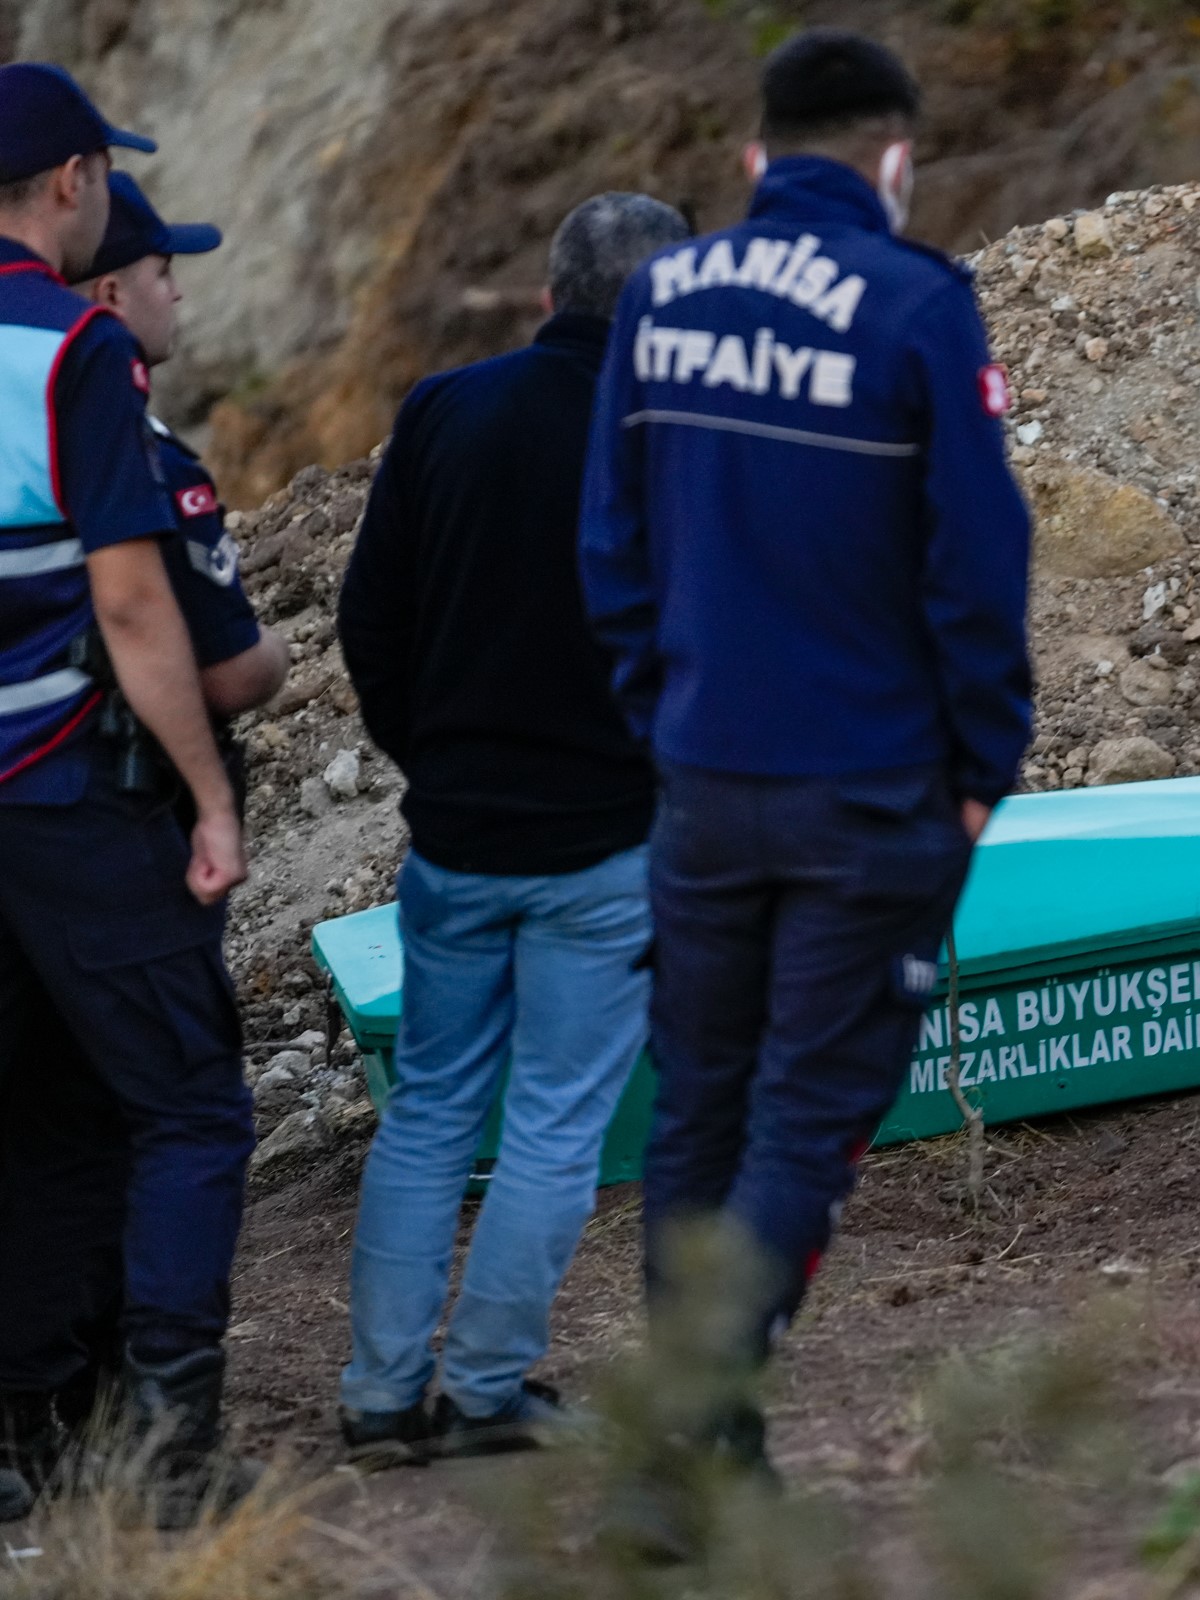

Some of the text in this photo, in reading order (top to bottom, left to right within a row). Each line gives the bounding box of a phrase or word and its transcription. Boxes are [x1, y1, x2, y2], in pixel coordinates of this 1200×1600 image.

[650, 233, 867, 333] MANİSA
[633, 316, 856, 407] İTFAİYE
[911, 998, 1005, 1053] NİSA
